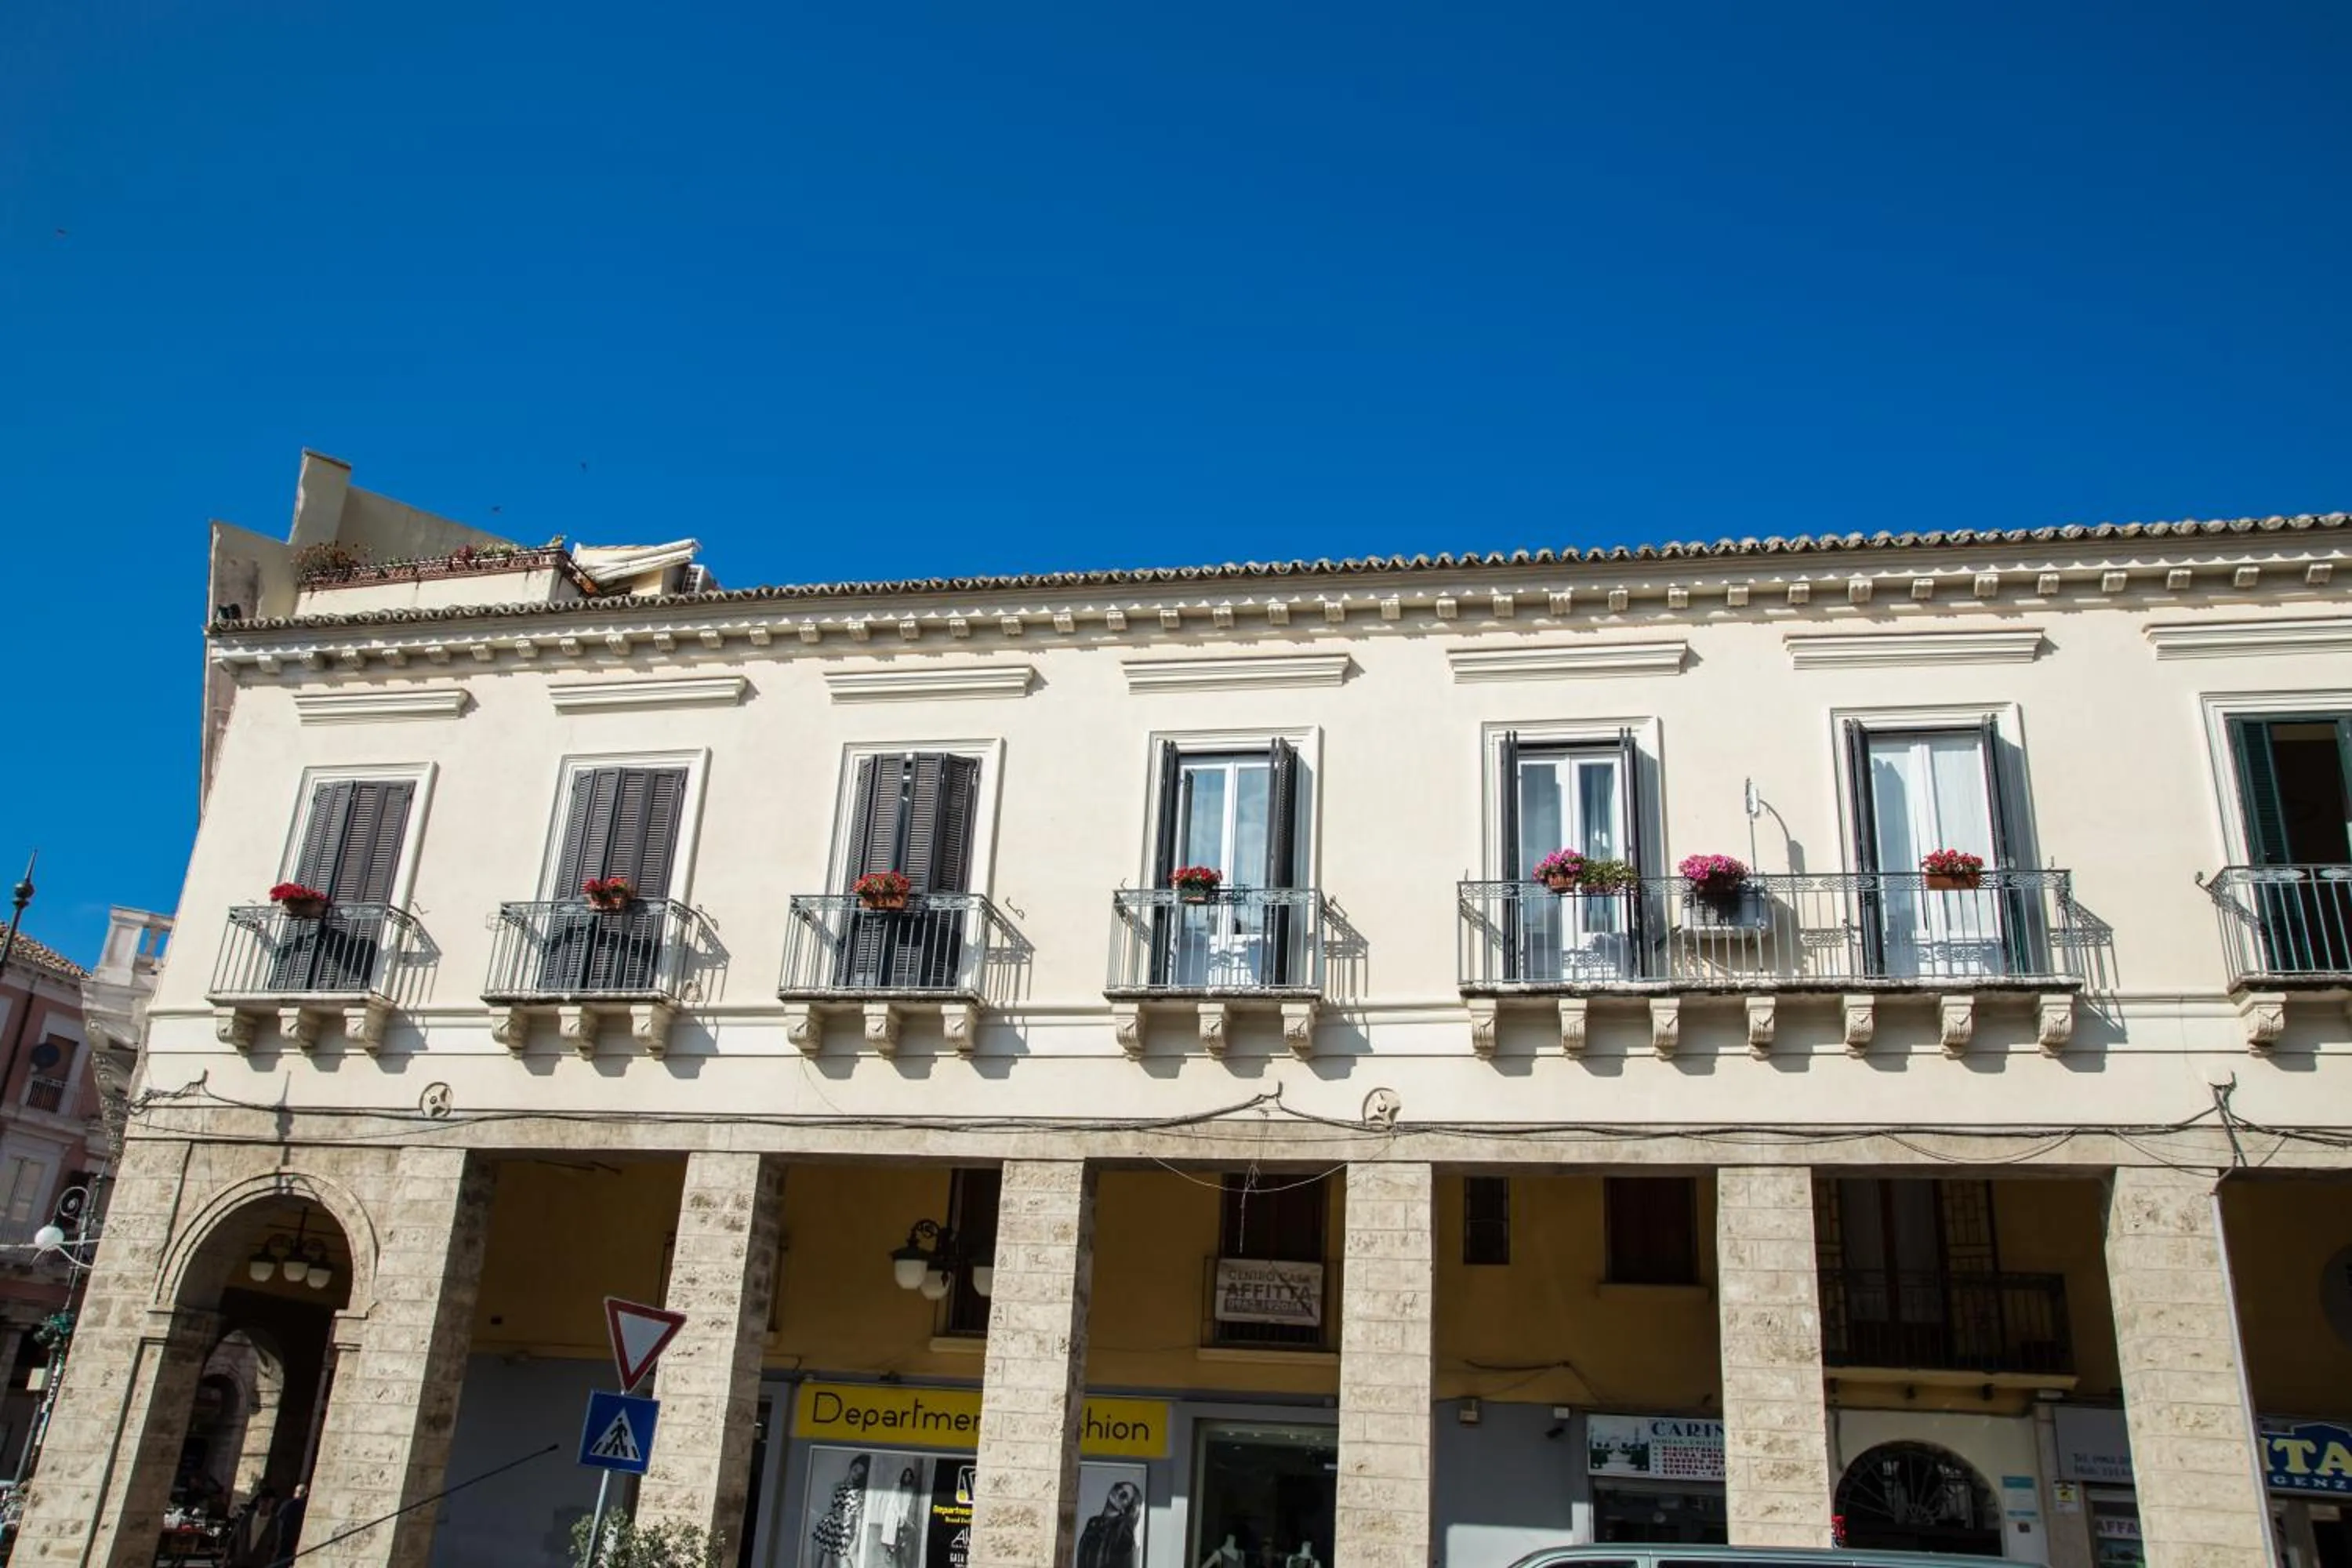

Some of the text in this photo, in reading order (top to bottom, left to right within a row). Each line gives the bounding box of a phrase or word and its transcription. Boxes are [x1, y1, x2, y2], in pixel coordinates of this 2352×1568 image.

[1226, 1282, 1312, 1300] AFFITTA
[1076, 1406, 1149, 1443] hion
[2259, 1438, 2352, 1477] ITA
[2272, 1475, 2347, 1489] GENZ
